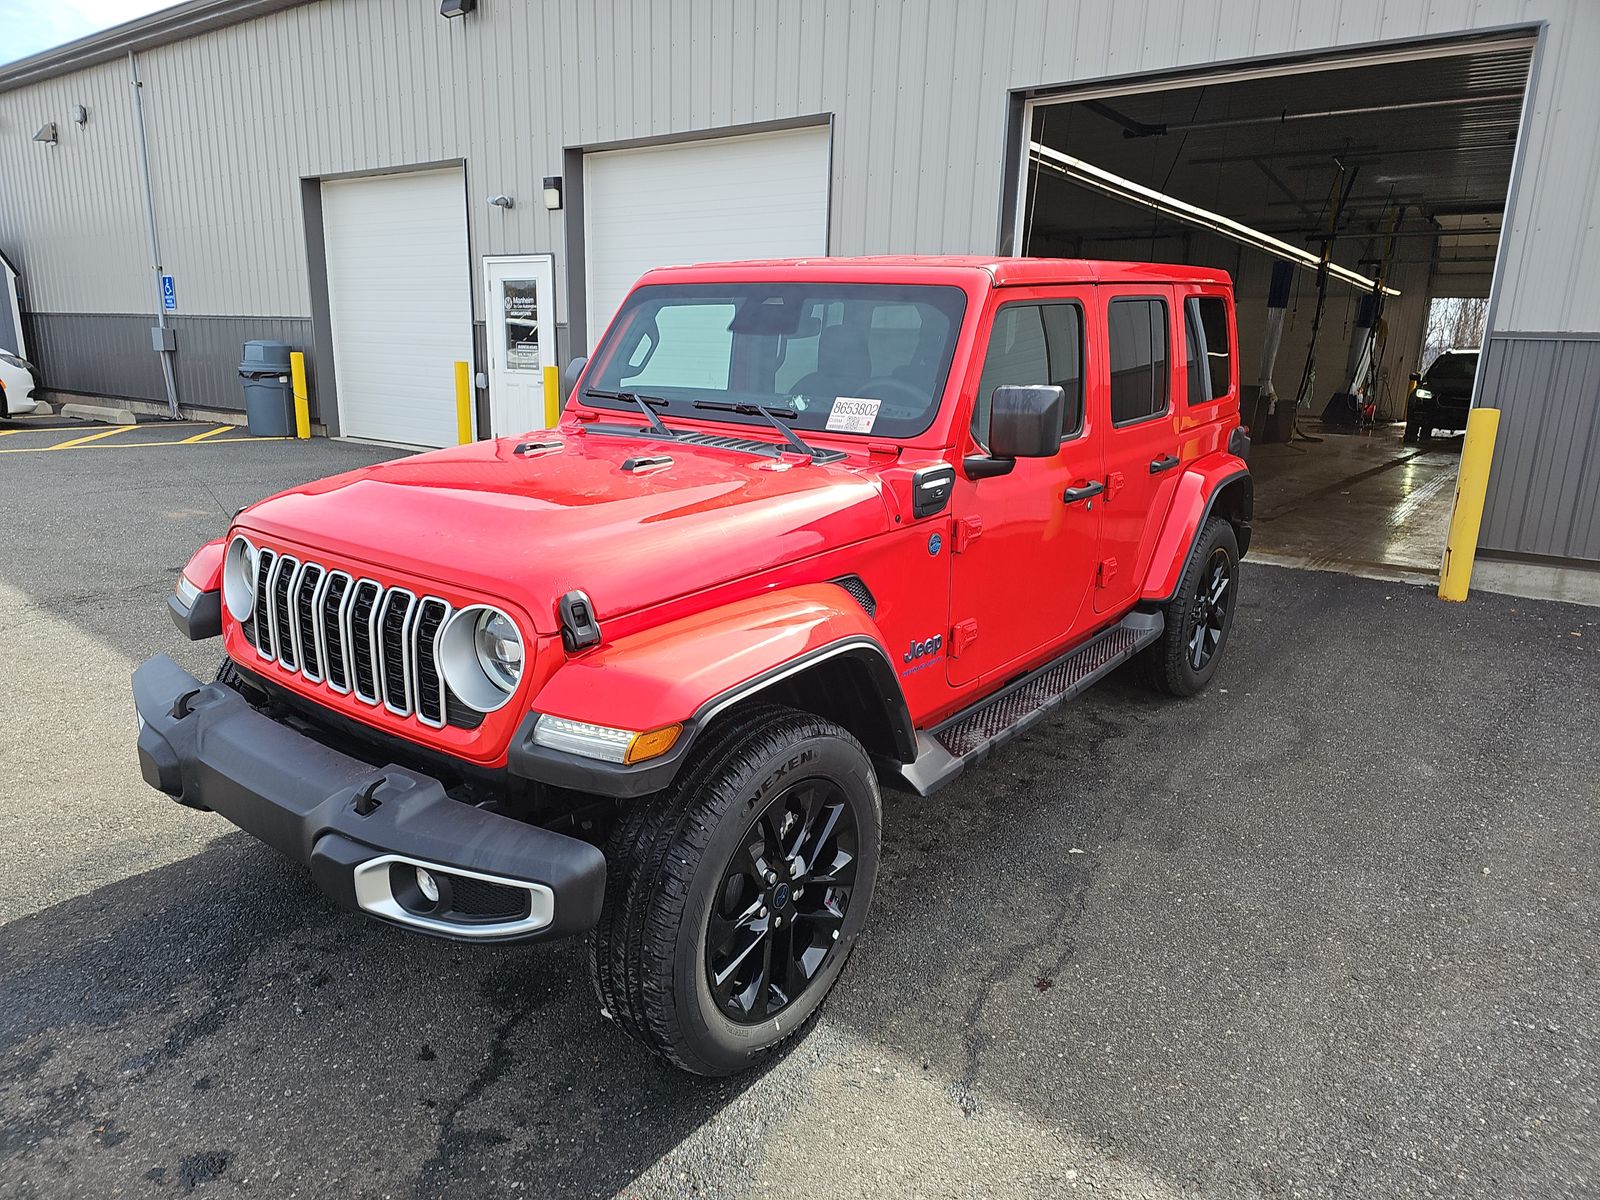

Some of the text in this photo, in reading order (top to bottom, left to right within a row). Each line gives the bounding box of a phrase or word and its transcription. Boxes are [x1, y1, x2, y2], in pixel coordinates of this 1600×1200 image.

[513, 296, 534, 304] Manheim
[833, 401, 879, 416] 8653802
[903, 634, 942, 663] Jeep
[747, 750, 813, 809] NEXEN
